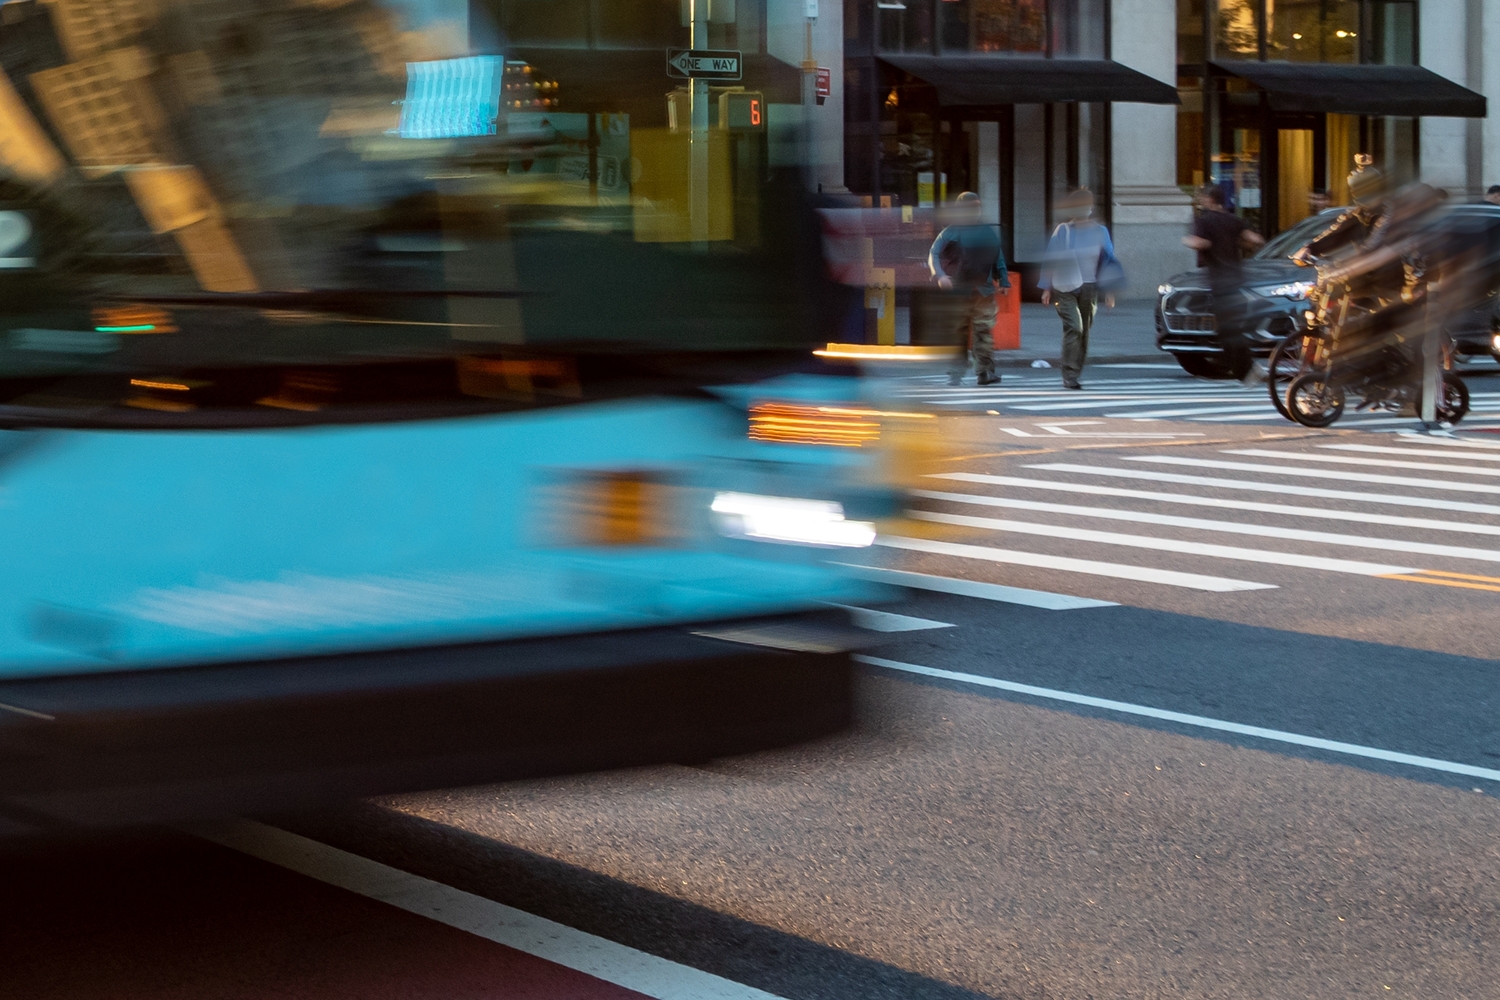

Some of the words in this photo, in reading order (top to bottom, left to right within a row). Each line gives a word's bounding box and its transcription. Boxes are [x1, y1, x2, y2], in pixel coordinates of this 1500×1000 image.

[680, 59, 701, 70] ONE
[712, 59, 735, 71] WAY
[750, 99, 761, 126] 6
